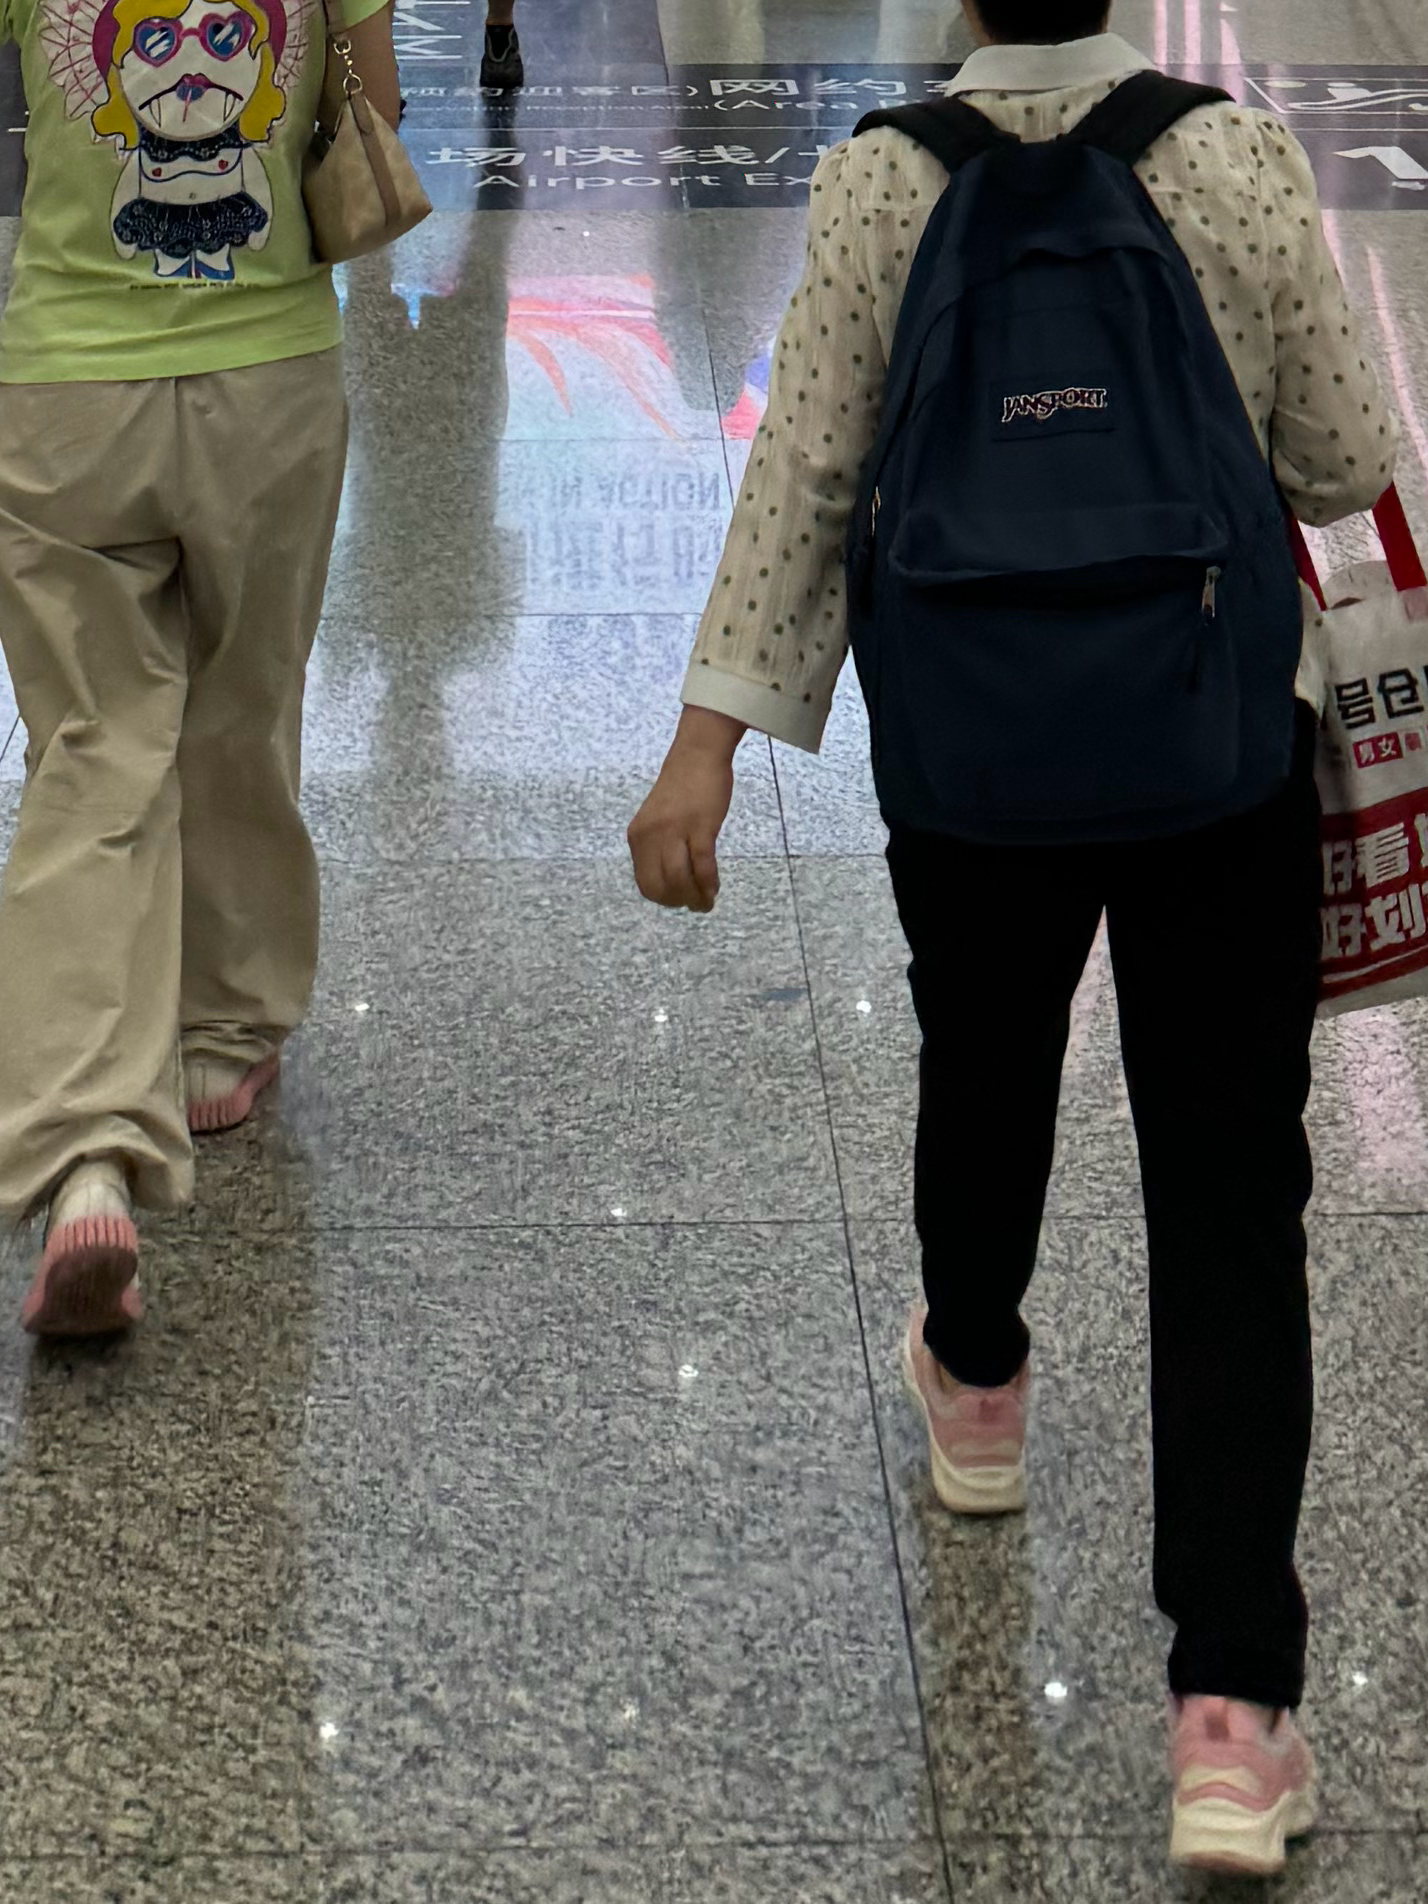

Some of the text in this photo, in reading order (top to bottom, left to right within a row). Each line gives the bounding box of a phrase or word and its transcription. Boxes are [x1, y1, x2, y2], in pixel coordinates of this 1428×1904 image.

[713, 98, 858, 111] (Area
[473, 174, 722, 190] Airport
[1000, 386, 1109, 423] JANSPORT
